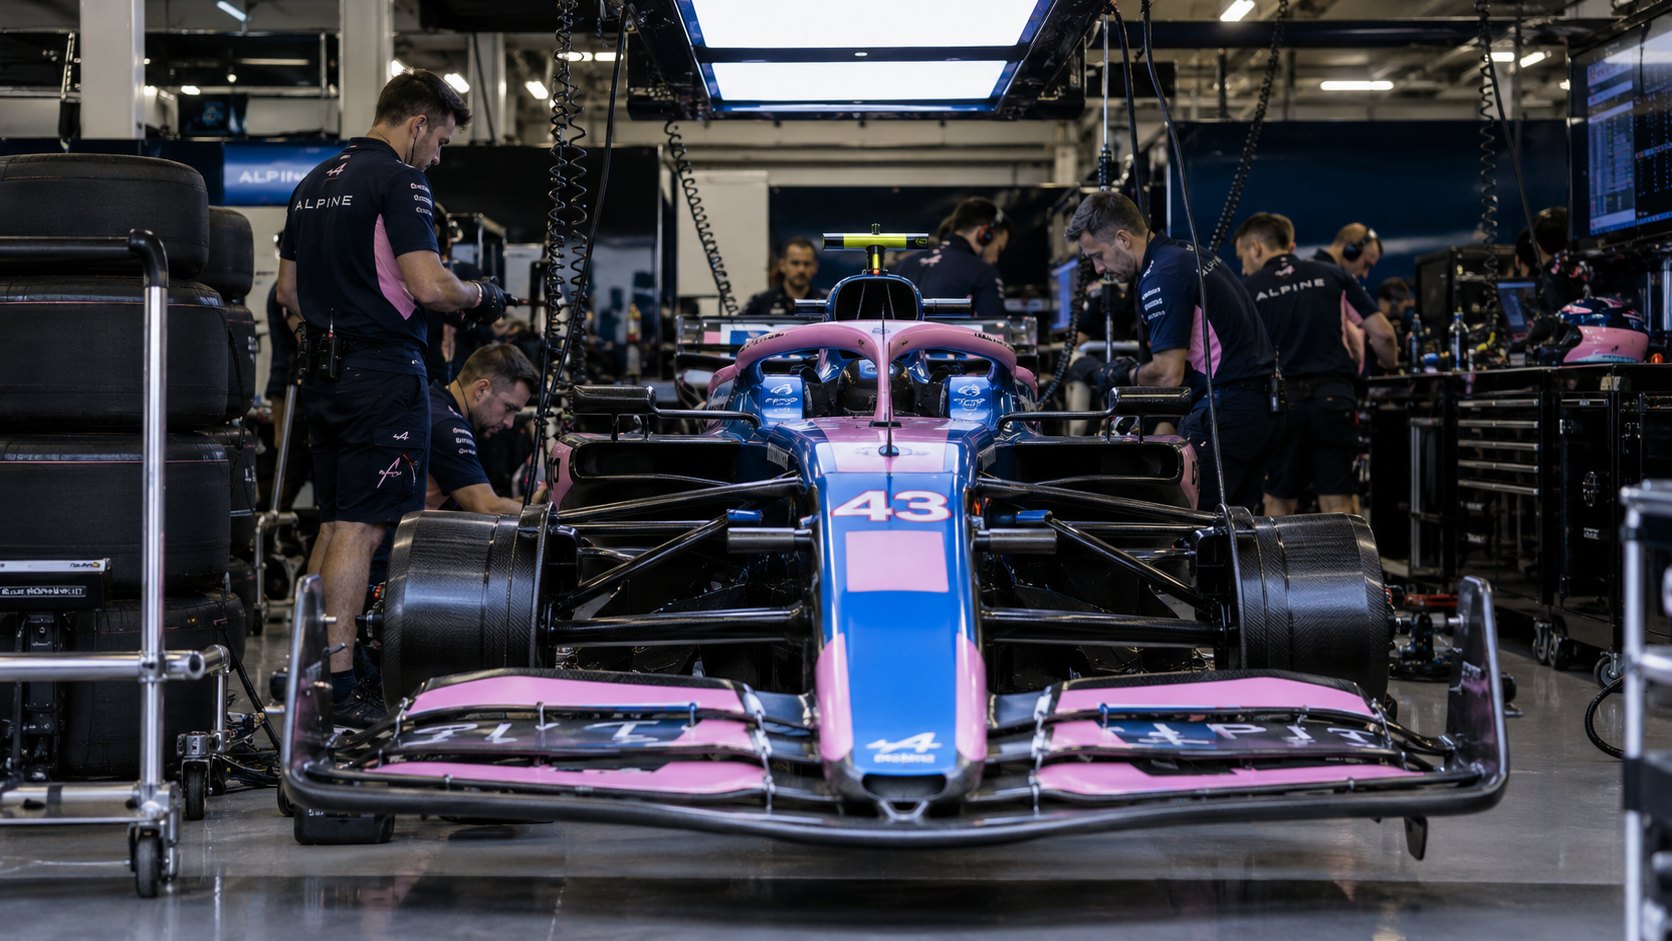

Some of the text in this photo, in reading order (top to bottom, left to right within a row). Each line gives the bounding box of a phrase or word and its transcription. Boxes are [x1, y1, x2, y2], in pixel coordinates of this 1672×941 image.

[295, 195, 353, 211] ALPINE
[1256, 278, 1325, 301] ALPINE
[830, 489, 952, 522] 43
